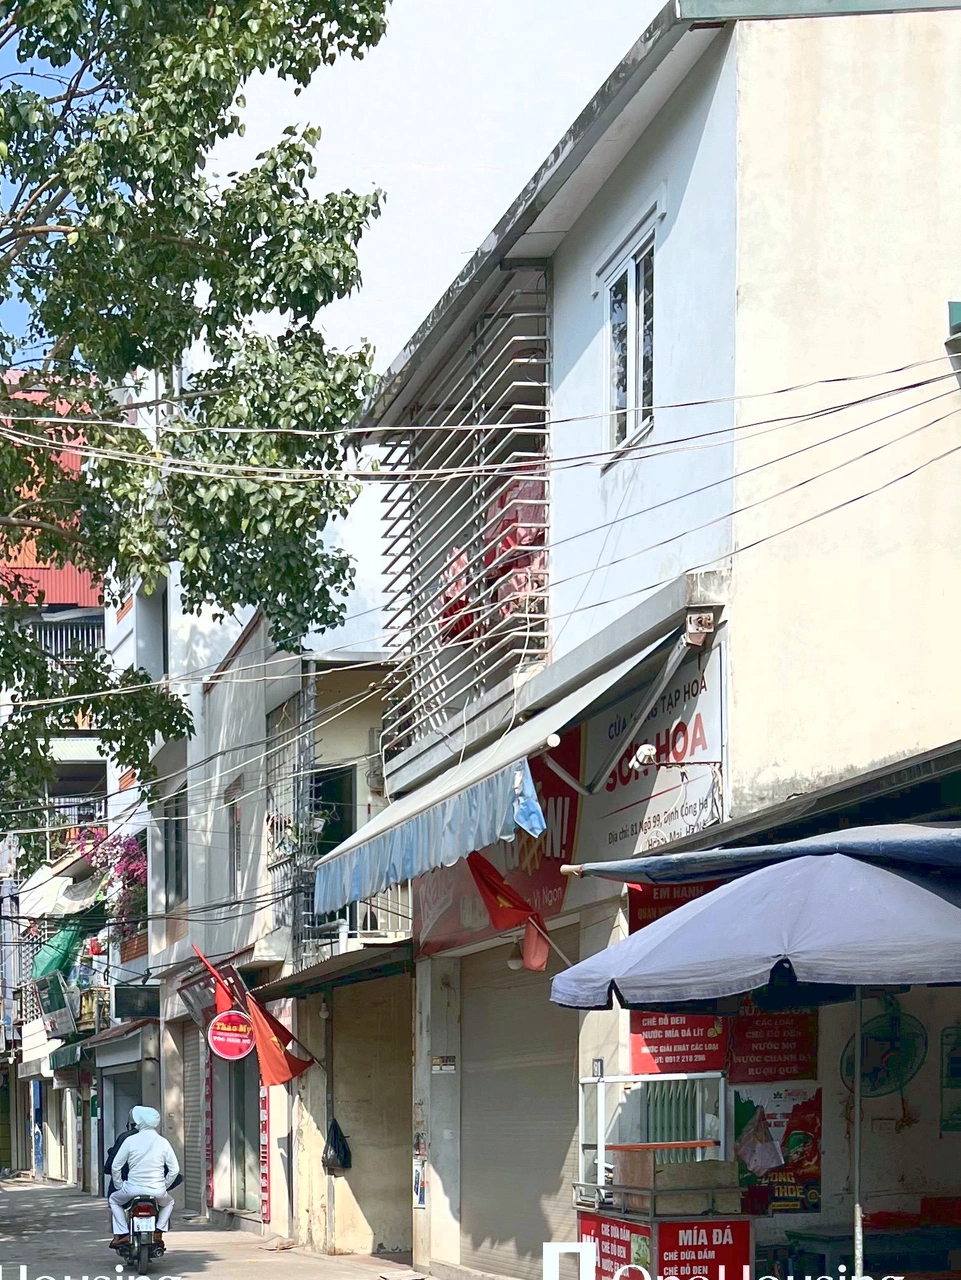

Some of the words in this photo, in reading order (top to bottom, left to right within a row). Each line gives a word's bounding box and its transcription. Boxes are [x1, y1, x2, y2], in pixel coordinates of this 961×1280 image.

[661, 688, 681, 715] TẠP
[655, 712, 707, 772] HOA
[608, 829, 618, 845] Địa
[630, 823, 638, 835] 81
[638, 816, 651, 836] Ngõ
[542, 887, 562, 907] Ngon
[653, 888, 669, 900] EM
[665, 1028, 679, 1038] MÍA
[693, 1027, 704, 1036] LÍT
[678, 1226, 708, 1246] MÍA
[712, 1225, 733, 1245] ĐÁ
[663, 1250, 679, 1261] CHÈ
[663, 1265, 679, 1276] CHÈ
